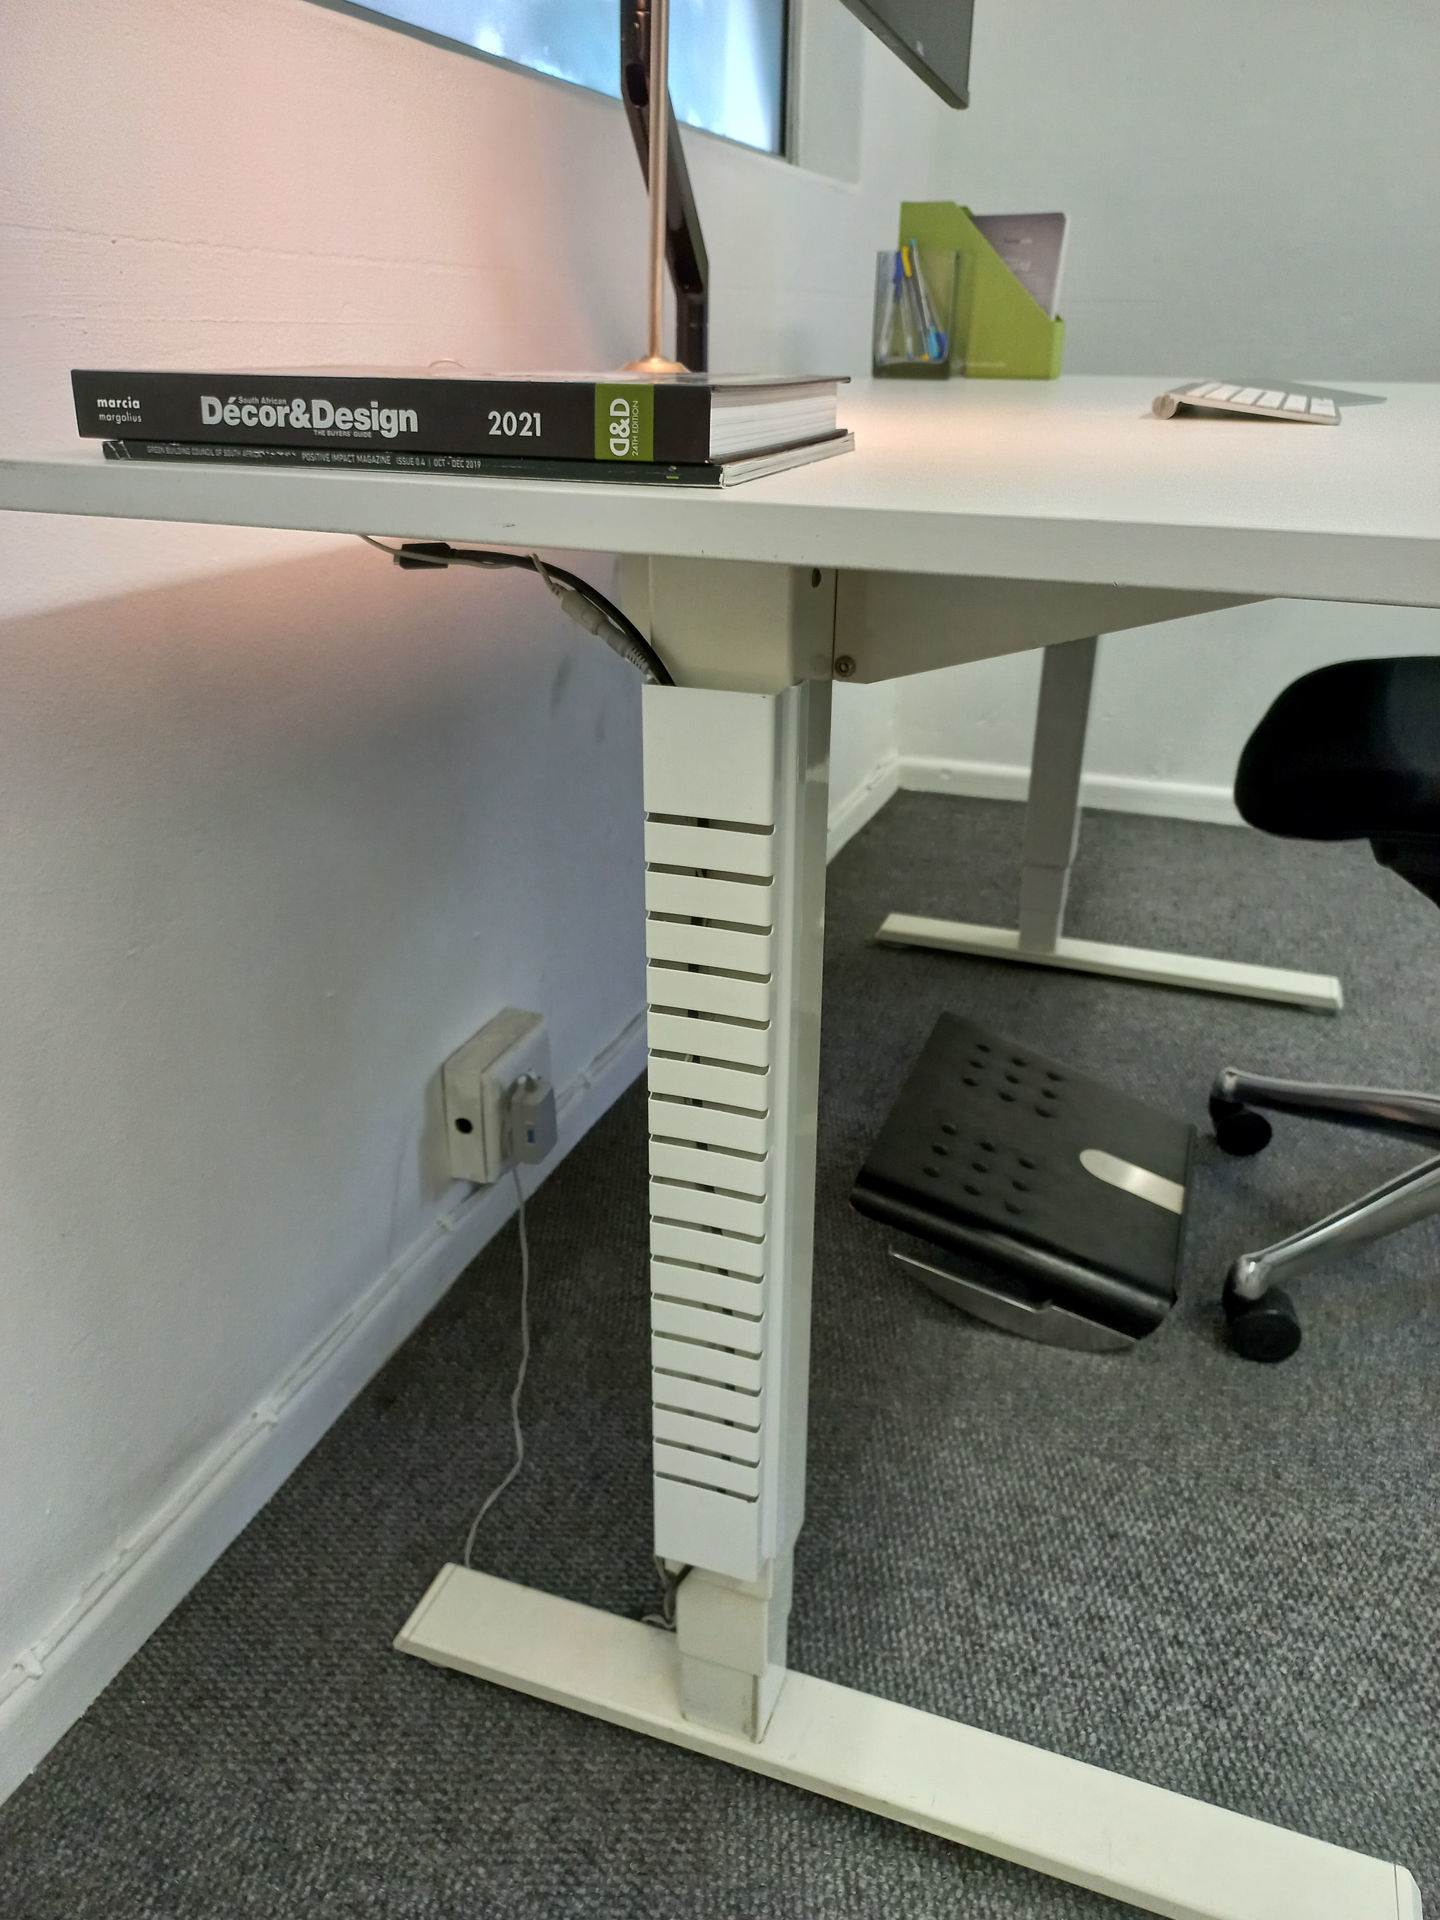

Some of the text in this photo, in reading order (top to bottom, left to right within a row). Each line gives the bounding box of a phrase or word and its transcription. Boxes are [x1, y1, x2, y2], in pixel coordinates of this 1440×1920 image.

[97, 396, 140, 409] marcia
[238, 396, 287, 405] South African
[99, 411, 142, 424] margolius
[200, 395, 419, 438] Décor&Design
[488, 410, 541, 437] 2021
[353, 430, 372, 438] GUIDE
[609, 398, 630, 456] D&D
[301, 452, 331, 462] POSITIVE
[332, 453, 355, 463] IMPACT
[356, 454, 391, 465] MAGAZINE
[395, 456, 415, 465] ISSUE
[433, 458, 445, 467] OCT
[451, 459, 464, 468] DEC
[465, 460, 481, 469] 2019
